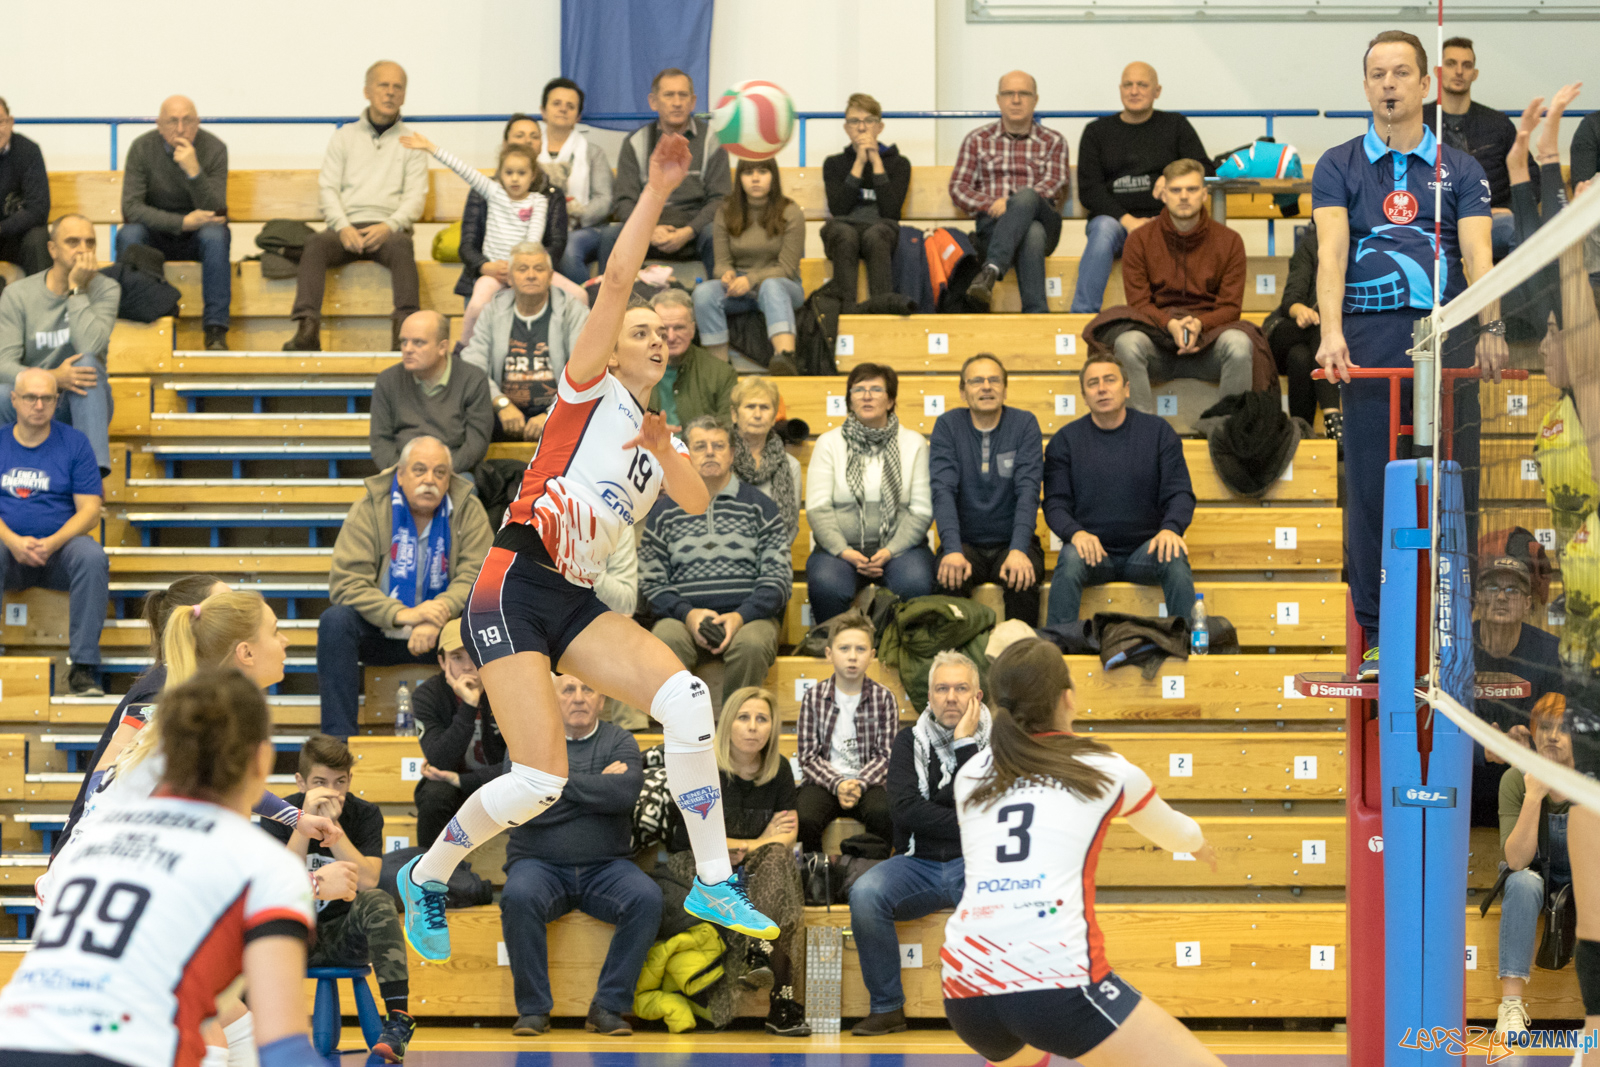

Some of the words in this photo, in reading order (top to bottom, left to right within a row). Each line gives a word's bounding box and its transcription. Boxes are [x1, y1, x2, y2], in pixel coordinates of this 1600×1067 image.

[1388, 207, 1400, 217] PZ
[1402, 207, 1413, 217] PS
[36, 328, 70, 349] PUM
[505, 356, 553, 371] CRE
[1512, 397, 1524, 410] 15
[627, 446, 653, 494] 19
[1527, 462, 1538, 473] 15
[601, 488, 635, 526] Enea
[1283, 531, 1289, 541] 1
[1539, 532, 1552, 543] 15
[13, 607, 20, 618] 9
[1285, 606, 1291, 616] 1
[478, 626, 502, 647] 19
[1170, 680, 1177, 690] 2
[1319, 684, 1363, 697] Senoh
[409, 762, 417, 773] 8
[1178, 758, 1185, 768] 2
[1303, 760, 1309, 771] 1
[996, 802, 1035, 863] 3
[1311, 844, 1317, 855] 1
[35, 876, 151, 959] 99
[907, 948, 915, 959] 4
[1185, 946, 1192, 957] 2
[1320, 951, 1326, 961] 1
[1099, 981, 1120, 1000] 3
